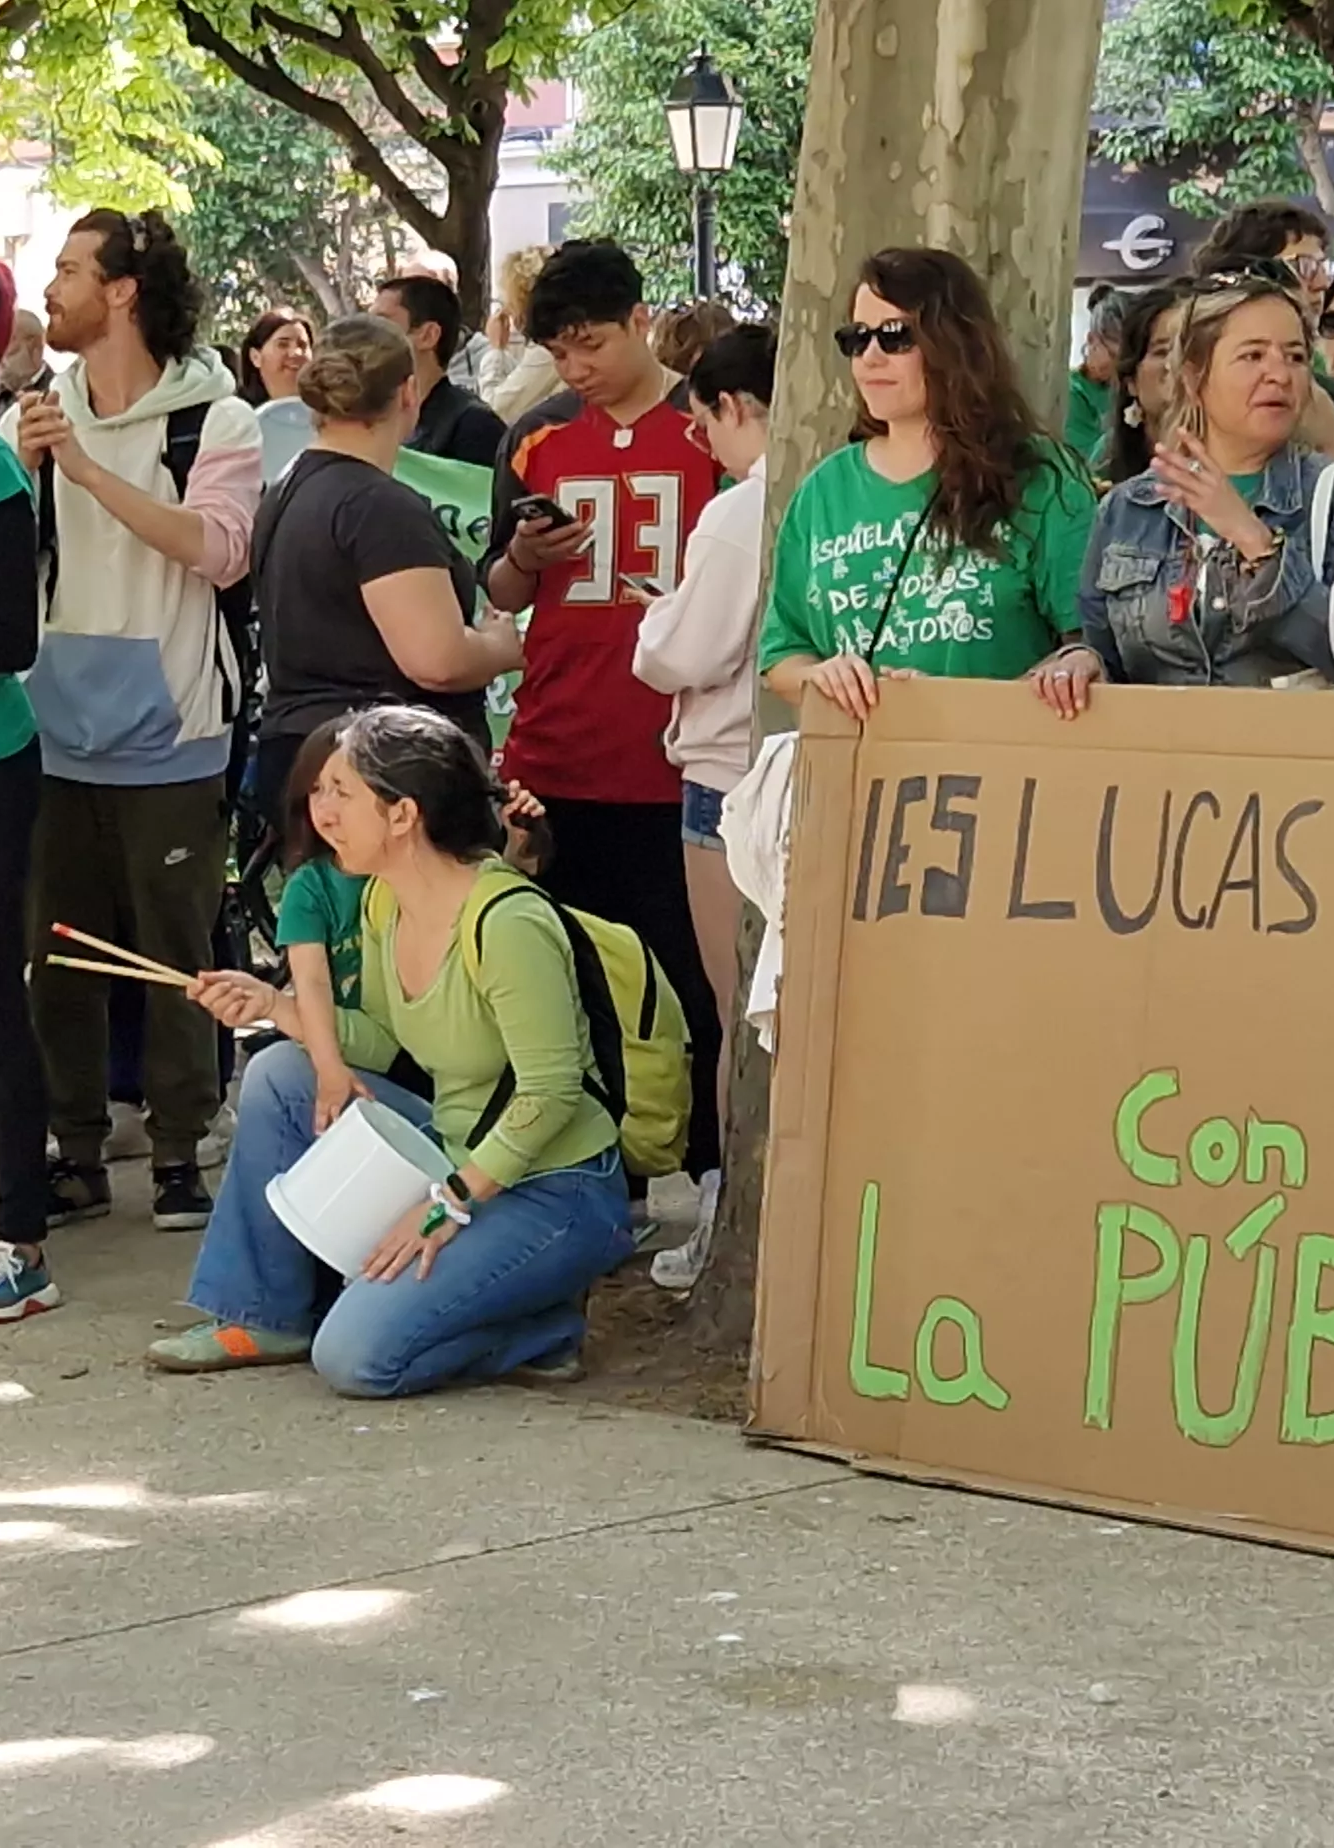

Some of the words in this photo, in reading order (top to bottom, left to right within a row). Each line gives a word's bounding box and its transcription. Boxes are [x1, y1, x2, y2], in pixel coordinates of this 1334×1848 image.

[554, 472, 683, 606] 93
[811, 520, 906, 568] ESCUELA
[829, 585, 868, 615] DE
[904, 612, 993, 643] TOD@S
[851, 775, 981, 923] IES
[1006, 777, 1325, 936] LUCAS
[1113, 1067, 1308, 1188] Con
[849, 1180, 1009, 1410] La
